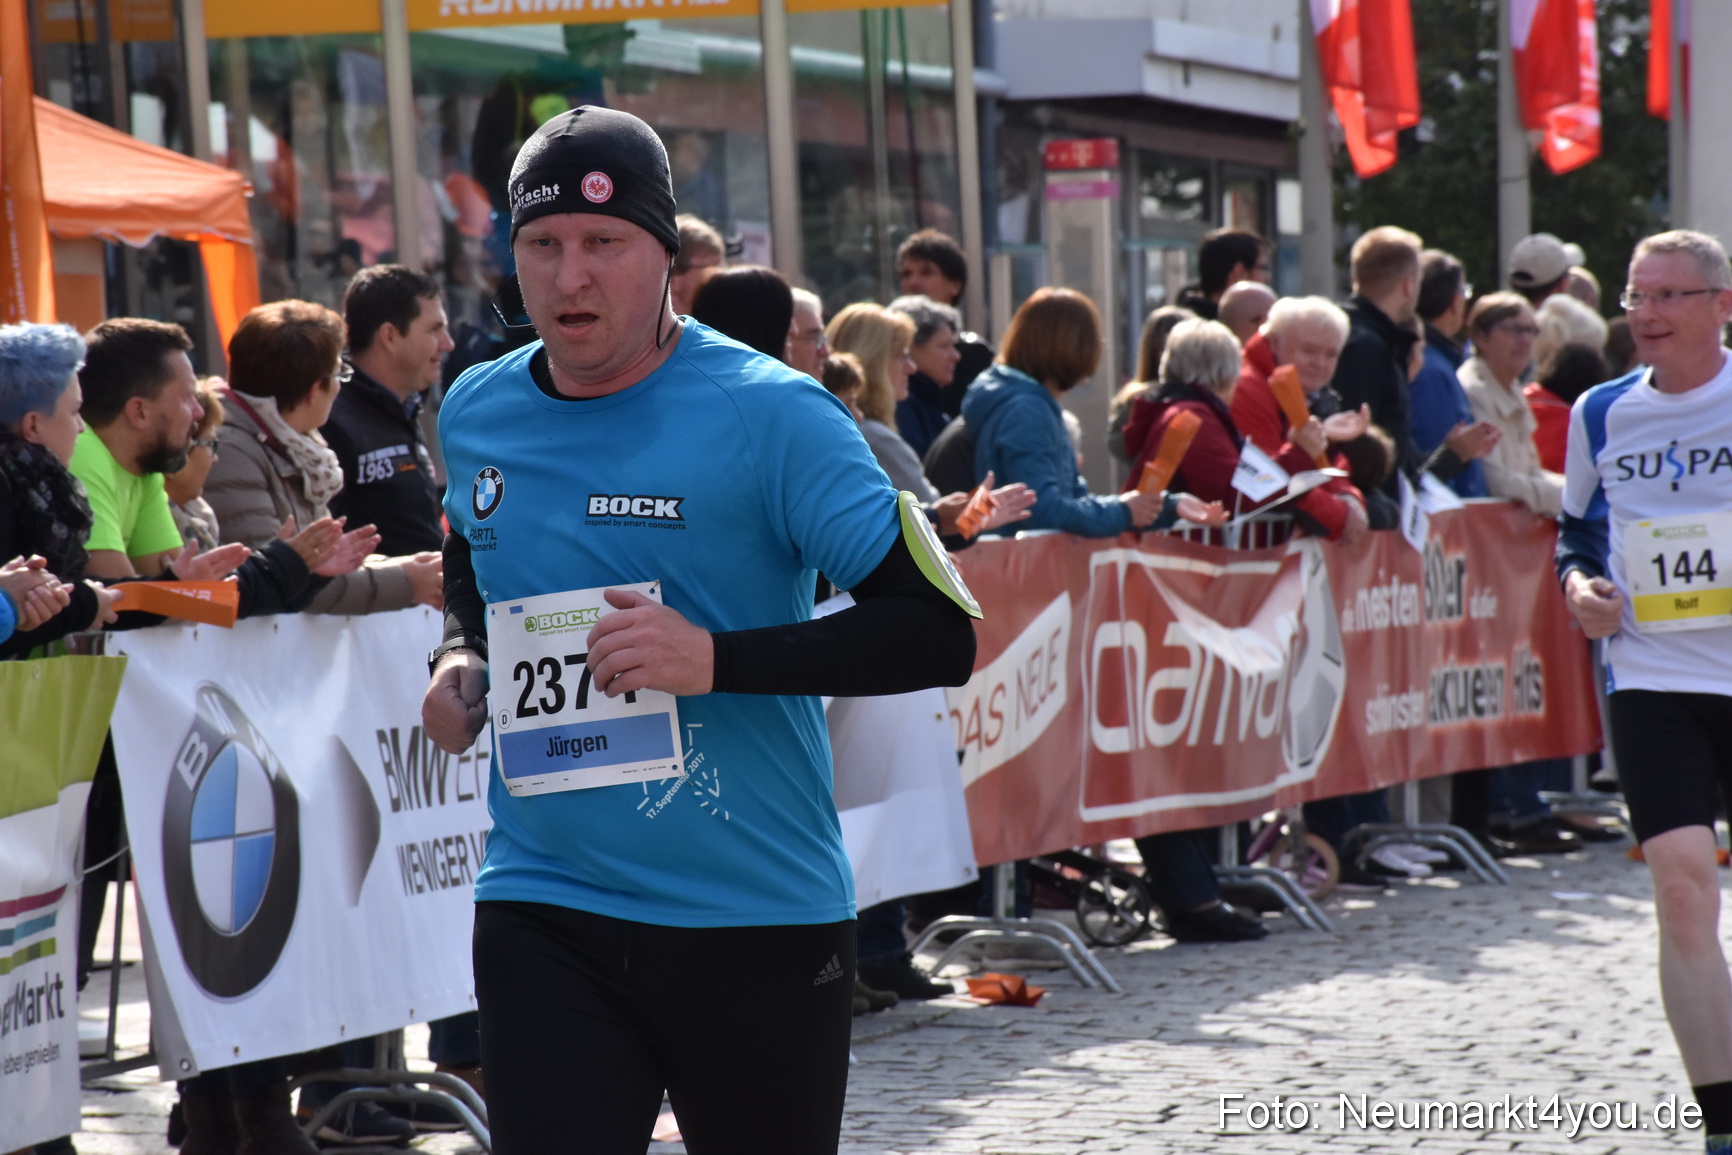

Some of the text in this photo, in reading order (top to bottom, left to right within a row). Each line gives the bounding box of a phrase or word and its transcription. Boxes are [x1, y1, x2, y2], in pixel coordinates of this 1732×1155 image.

[522, 195, 557, 210] FRANKFURT
[357, 458, 395, 484] 1963
[475, 468, 502, 487] BMW
[587, 495, 684, 520] BOCK
[585, 518, 686, 531] inspired by smart concepts
[1652, 549, 1717, 586] 144
[537, 606, 601, 631] BOCK
[501, 714, 508, 725] D
[546, 734, 608, 758] Jürgen
[376, 722, 451, 814] BMW
[645, 807, 661, 819] 17.
[687, 752, 705, 773] 2017
[397, 834, 474, 897] WENIGER
[813, 968, 844, 986] adidas
